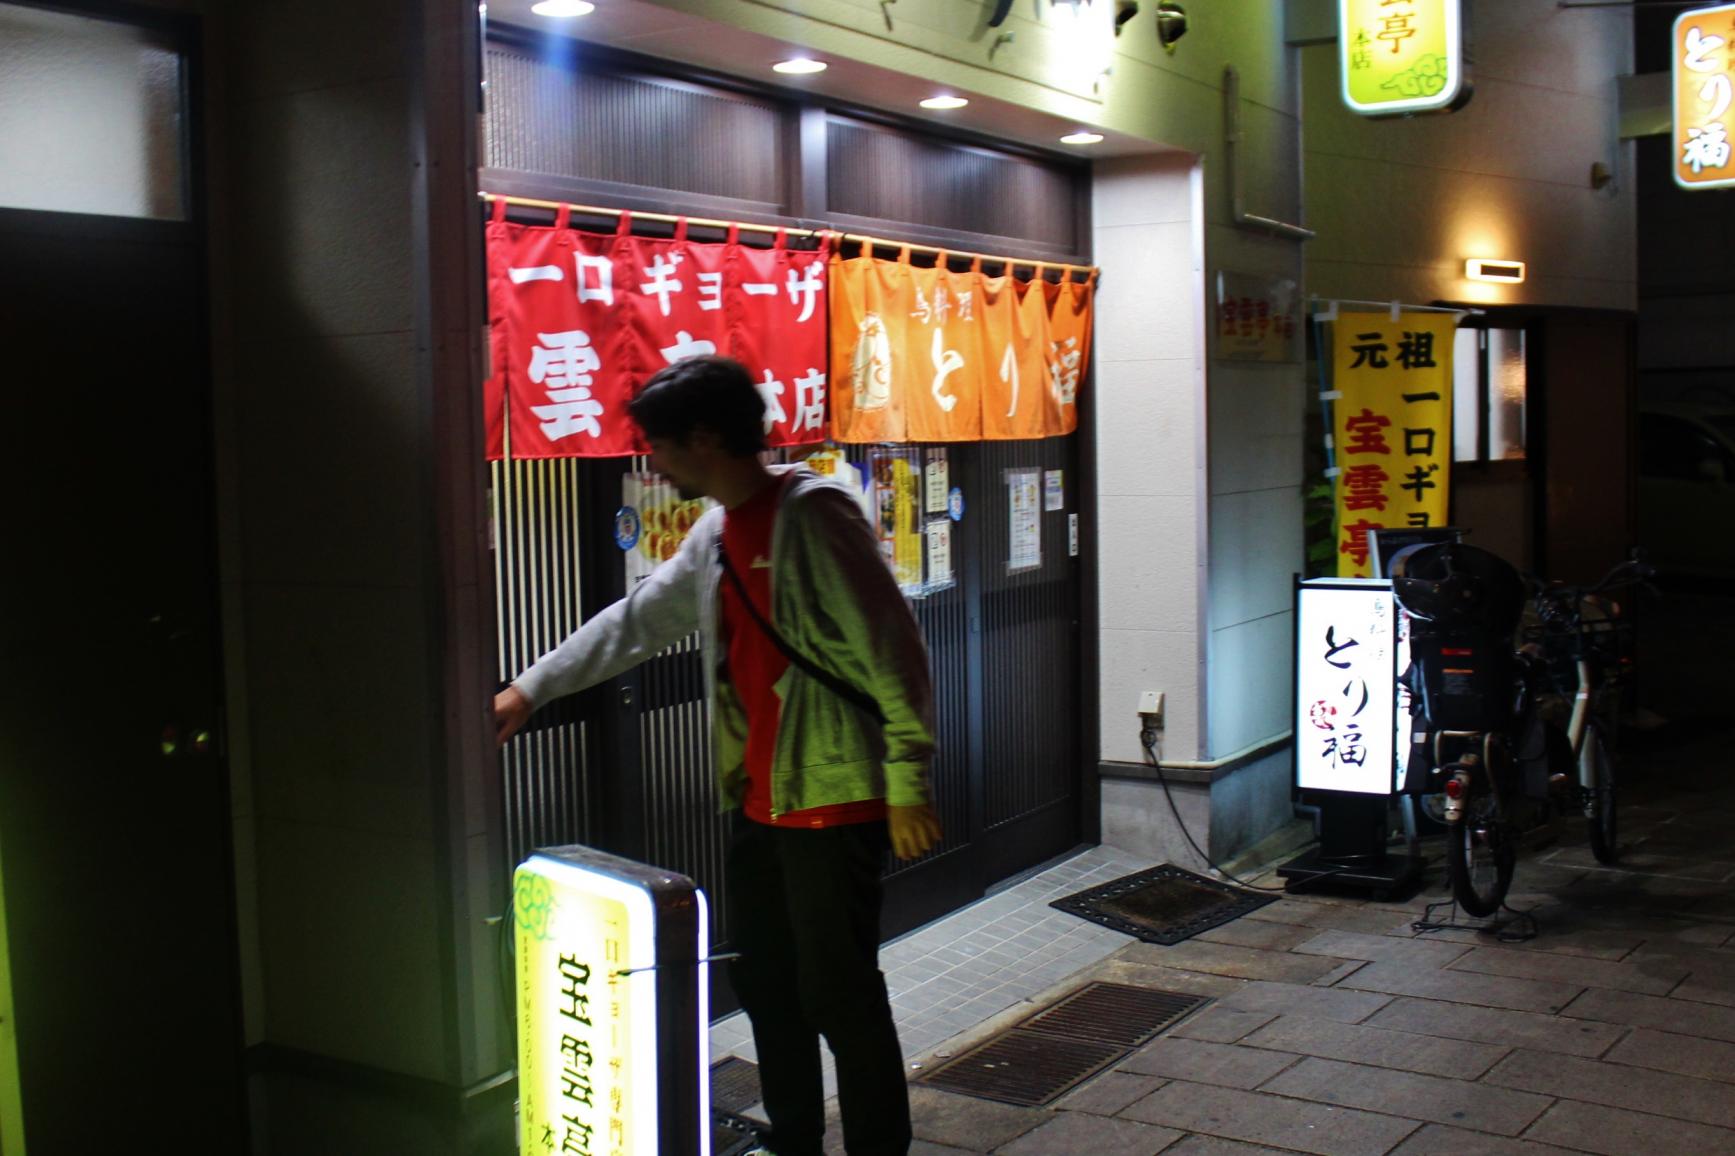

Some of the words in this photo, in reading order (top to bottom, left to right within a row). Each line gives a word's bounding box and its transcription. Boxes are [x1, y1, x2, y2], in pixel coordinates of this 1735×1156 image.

[1376, 0, 1416, 54] 亭
[1683, 26, 1733, 173] とり福
[508, 249, 824, 322] 一口ギョーザ
[1348, 331, 1437, 370] 元祖
[1340, 408, 1392, 578] 宝雲亭
[1322, 625, 1369, 769] とり福
[604, 918, 624, 1156] 一口ギョーザ専門
